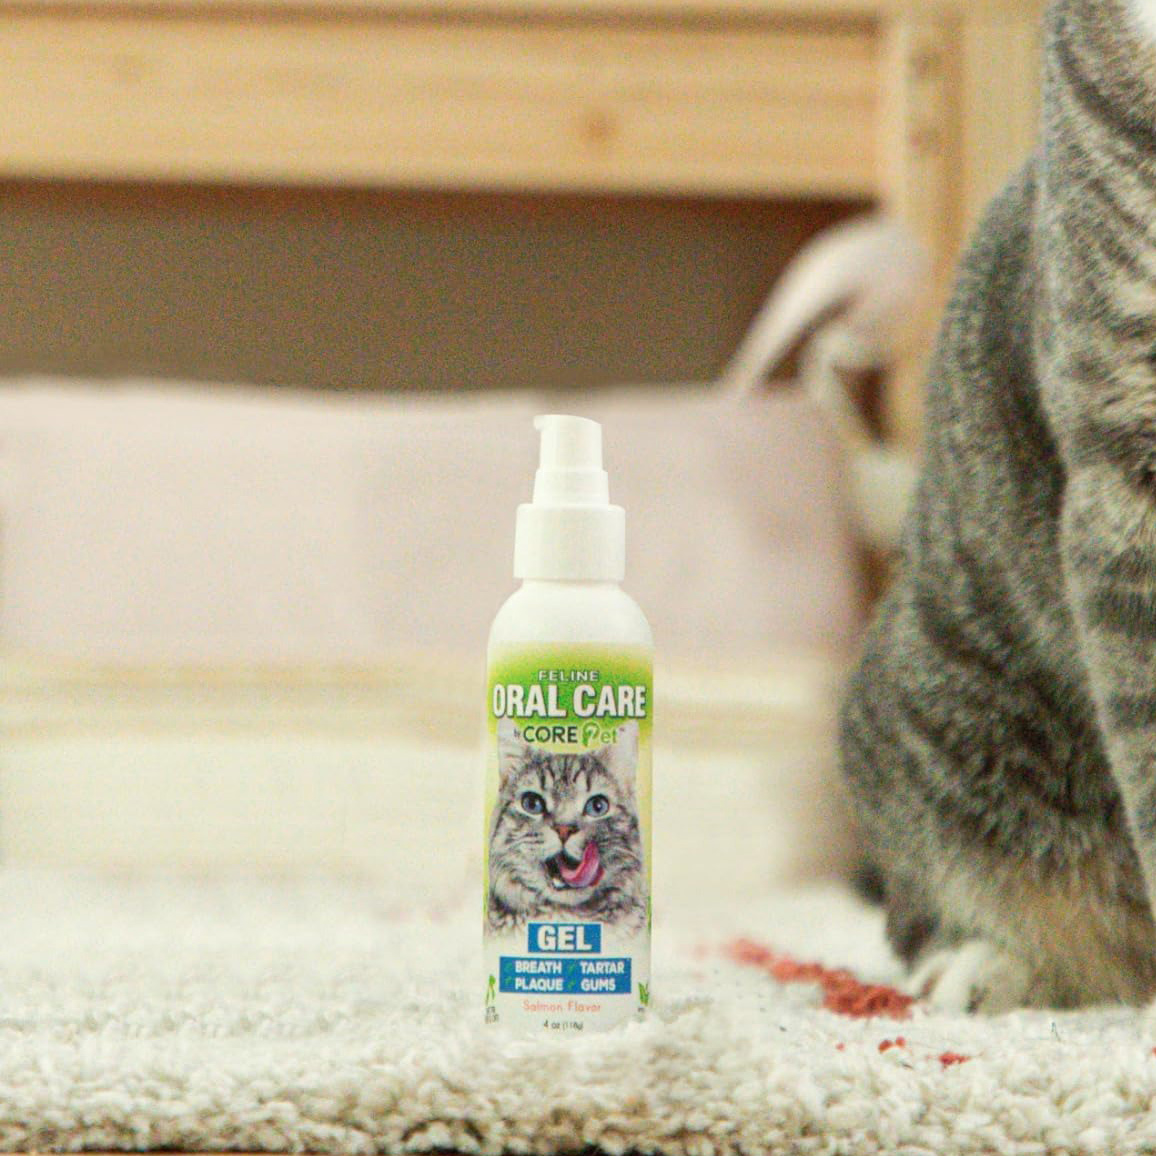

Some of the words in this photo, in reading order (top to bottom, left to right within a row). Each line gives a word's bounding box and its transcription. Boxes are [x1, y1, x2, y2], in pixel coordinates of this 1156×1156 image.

[538, 670, 600, 682] FELINE
[493, 684, 568, 718] ORAL
[573, 684, 647, 719] CARE
[523, 726, 578, 744] CORE
[582, 722, 617, 747] Pet
[537, 925, 592, 951] GEL
[515, 960, 562, 974] BREATH
[580, 961, 625, 975] TARTAR
[515, 978, 563, 992] PLAQUE
[581, 978, 616, 992] GUMS
[523, 1000, 562, 1013] Salmon
[568, 1000, 602, 1013] Flavor
